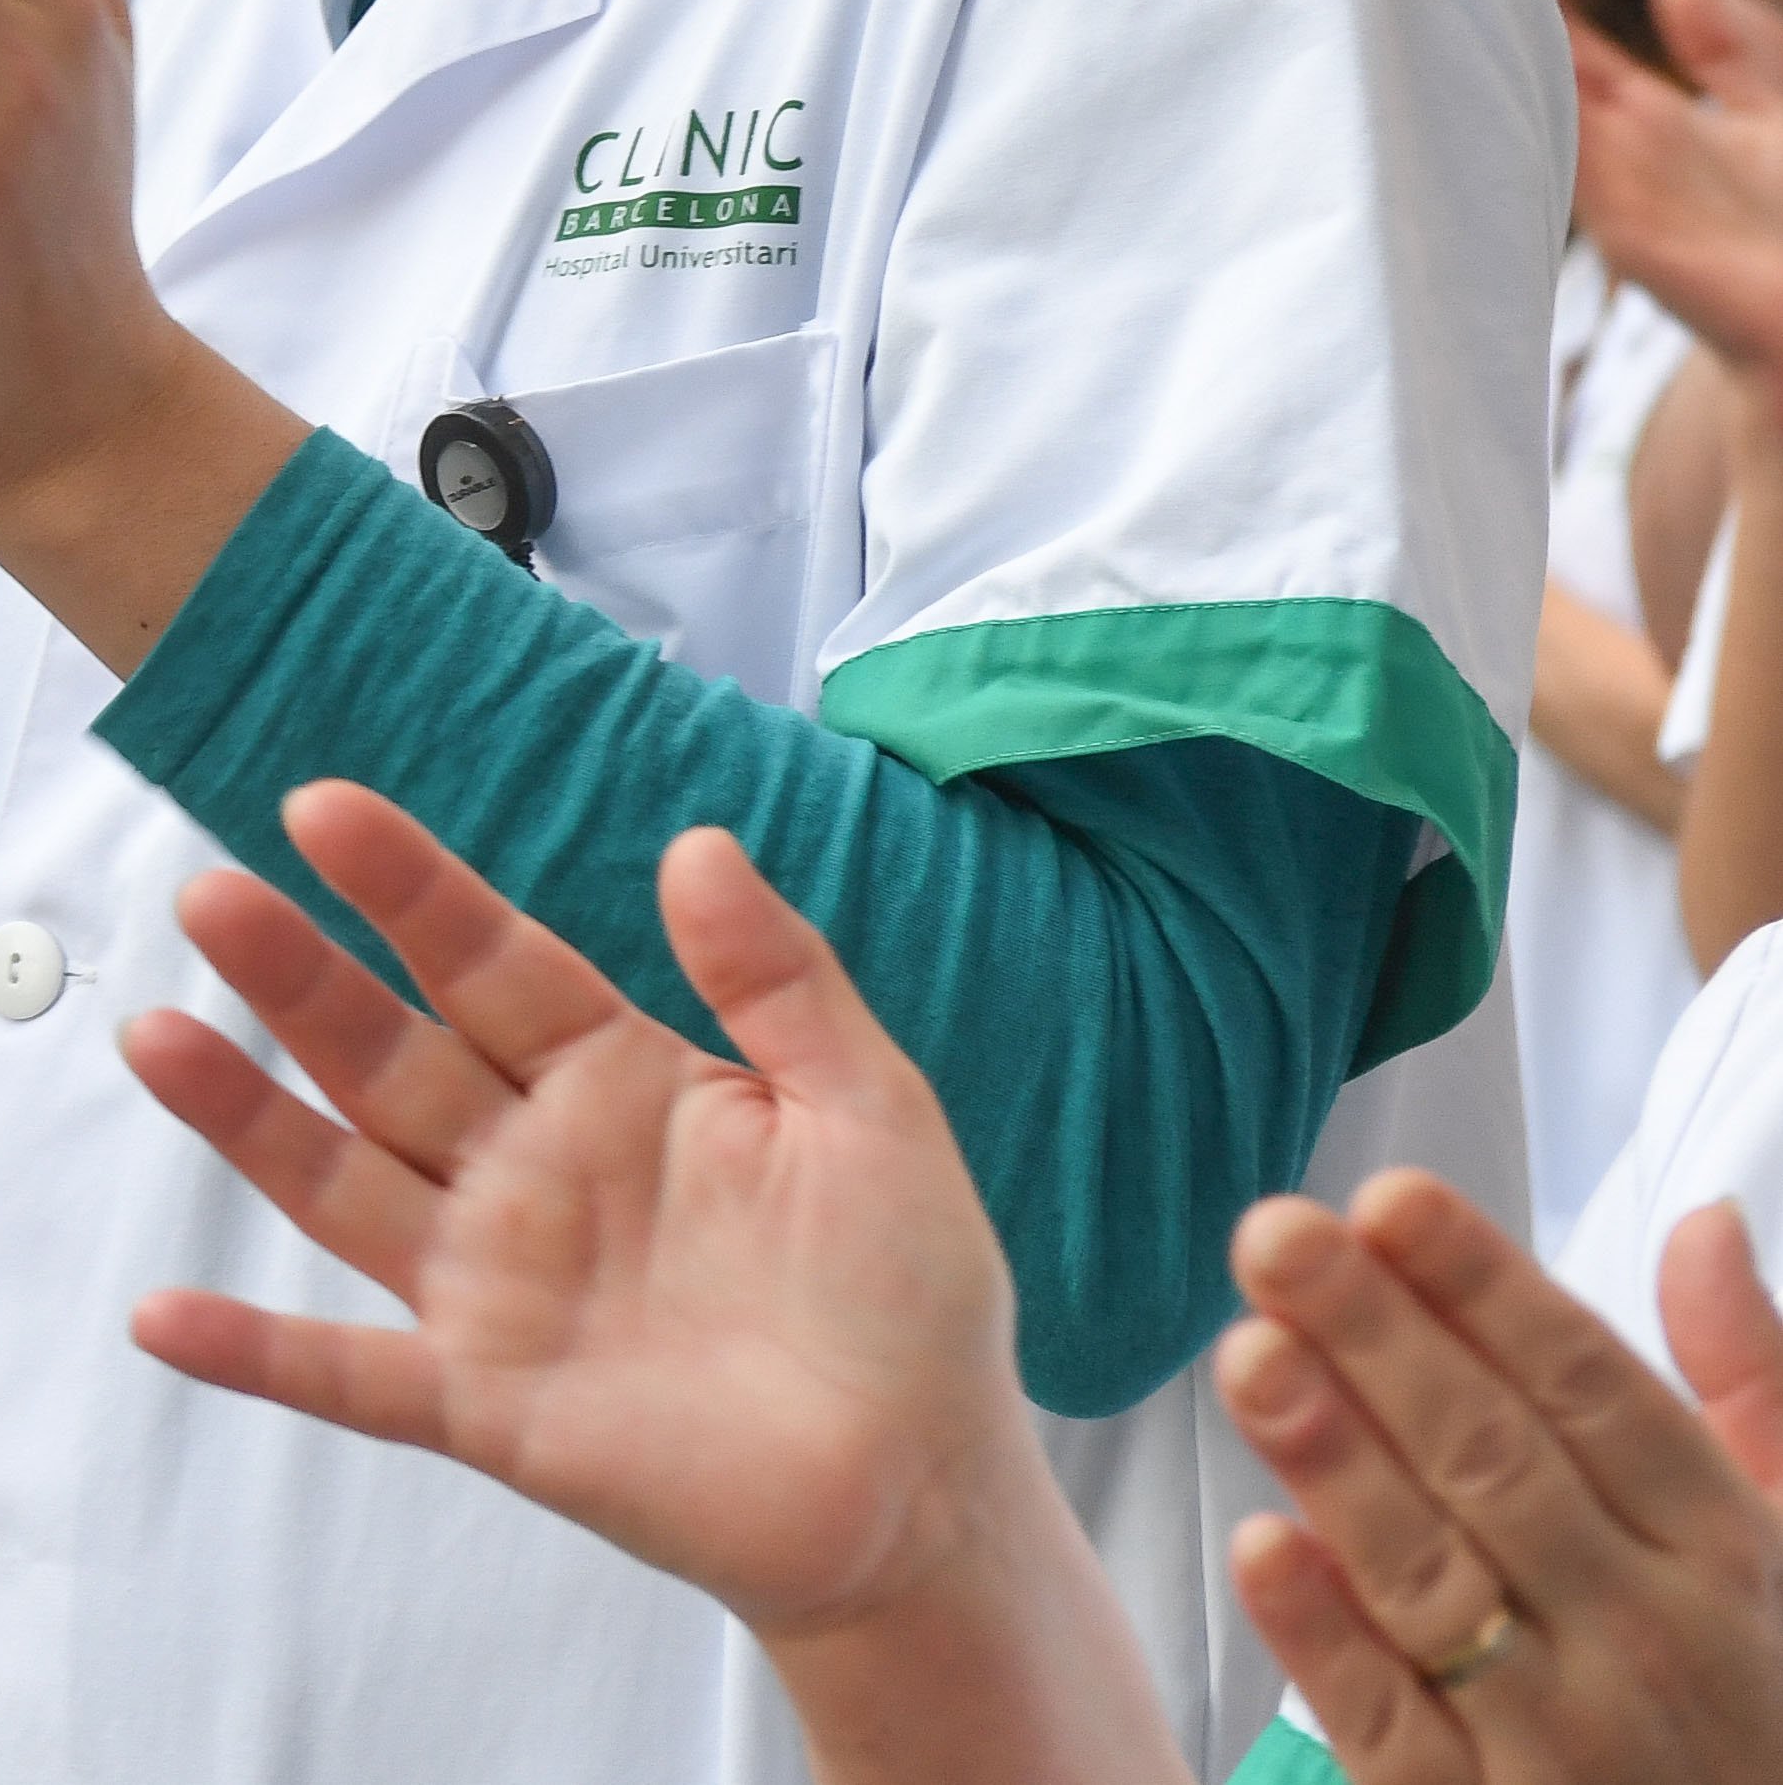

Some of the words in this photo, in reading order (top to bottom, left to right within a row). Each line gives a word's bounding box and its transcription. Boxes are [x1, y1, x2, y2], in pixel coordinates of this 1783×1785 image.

[562, 192, 794, 236] BARCELONA
[543, 245, 630, 280] Hospital
[639, 240, 799, 270] Universitari
